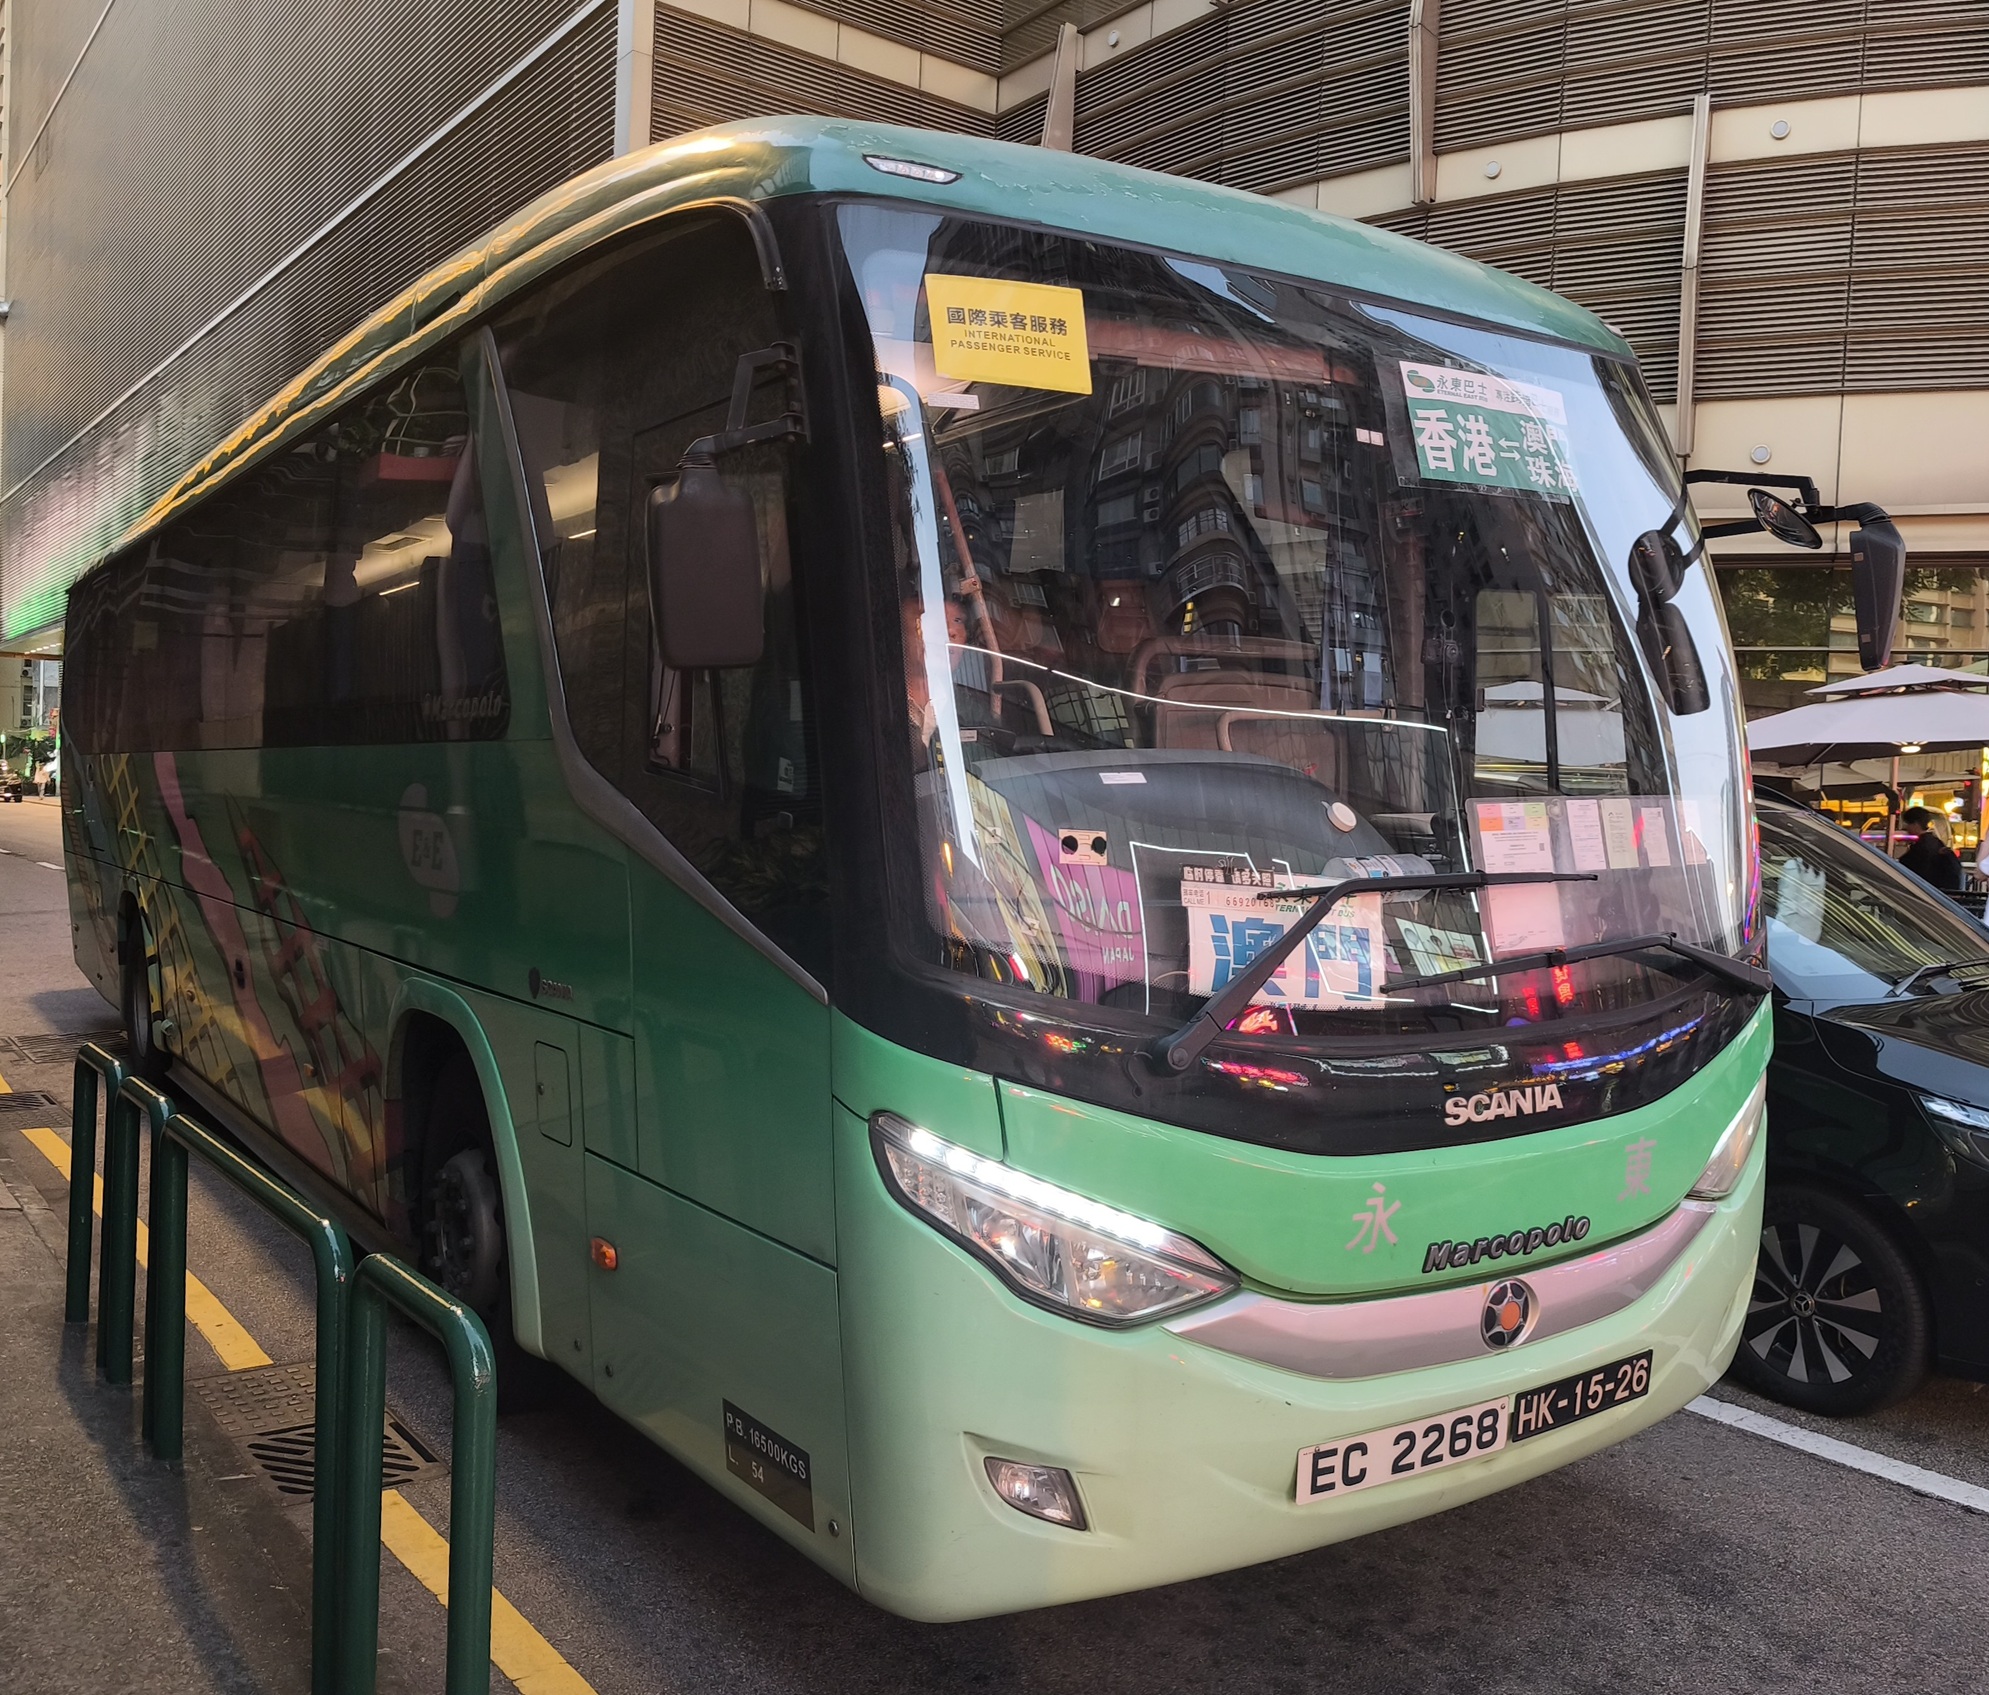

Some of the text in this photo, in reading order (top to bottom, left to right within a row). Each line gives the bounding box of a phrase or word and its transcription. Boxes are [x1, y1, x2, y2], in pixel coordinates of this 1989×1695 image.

[946, 306, 1068, 337] 國際乘客服務
[964, 329, 1056, 347] INTERNATIONAL
[951, 339, 1071, 361] PASSENGER SERVICE
[1437, 374, 1487, 396] 永東巴士
[1437, 389, 1463, 398] ETERNAL
[1413, 408, 1498, 478] 香港
[1524, 455, 1579, 493] 珠海
[1444, 1084, 1564, 1127] SCANIA
[1345, 1136, 1658, 1255] 永 東
[1422, 1215, 1591, 1274] Marcopolo
[1516, 1357, 1649, 1436] HK-15-26
[749, 1427, 807, 1480] 16500KGS
[751, 1461, 764, 1483] 54
[1310, 1408, 1499, 1496] EC 2268
